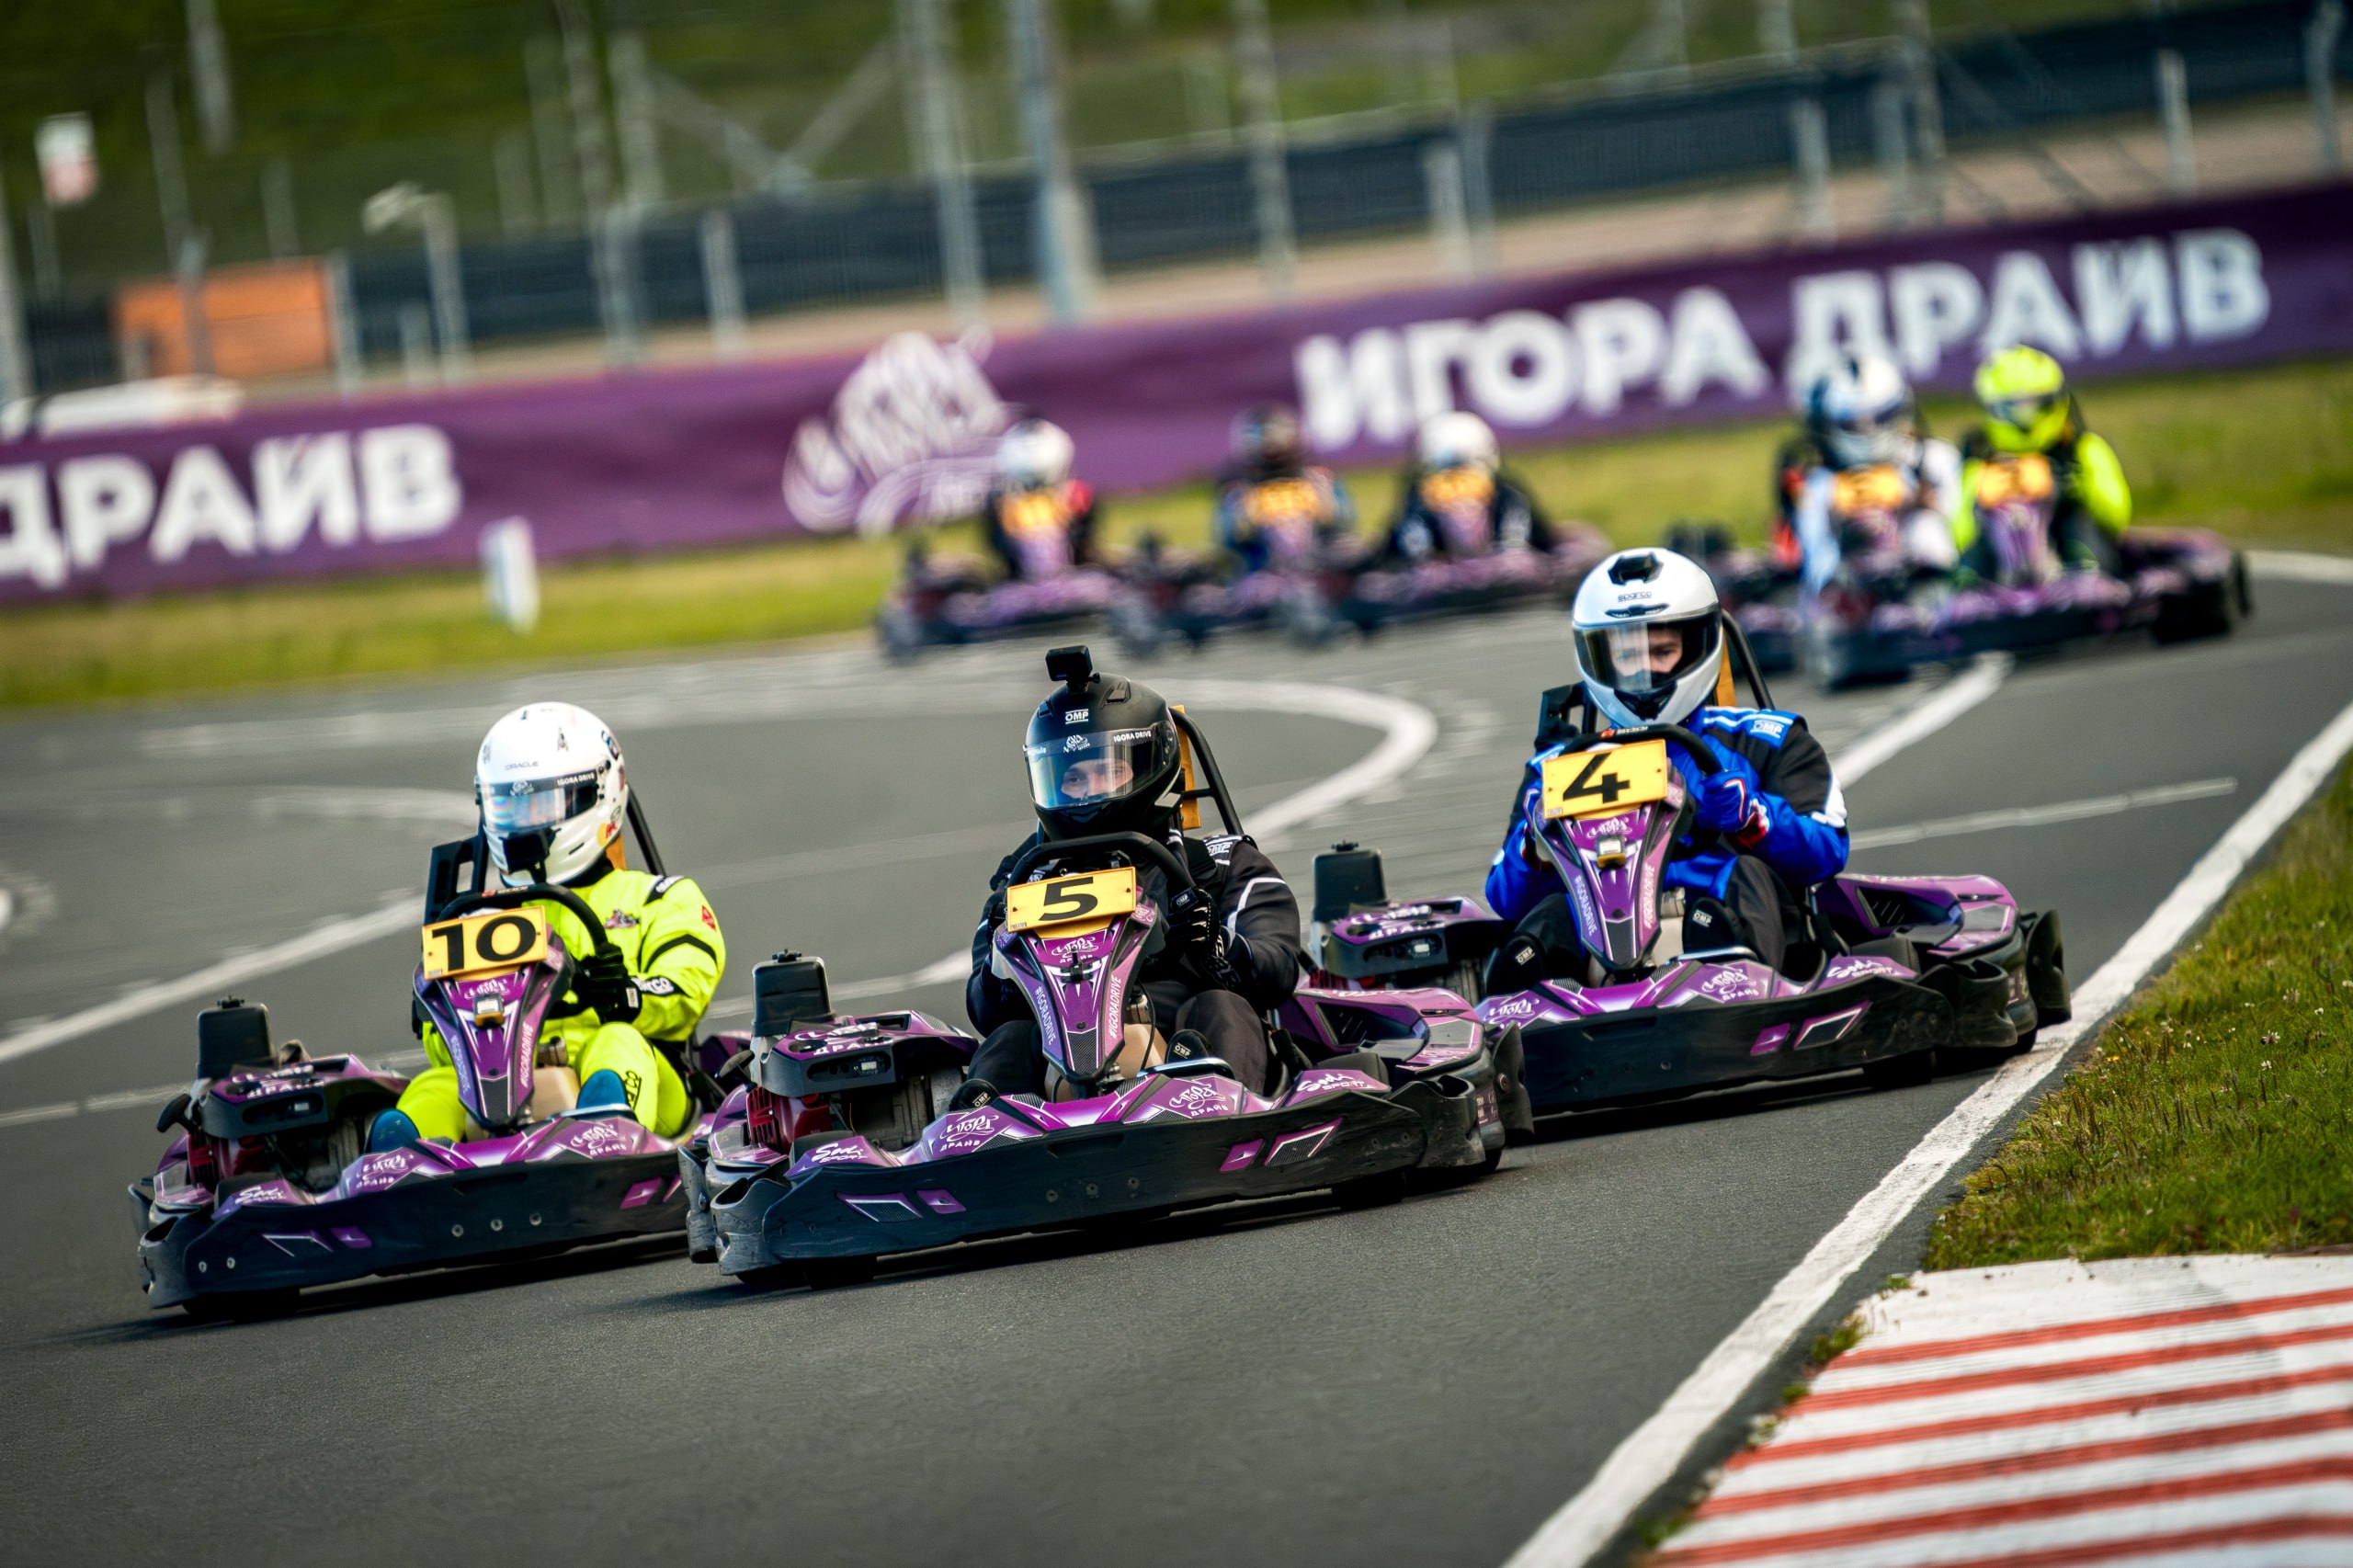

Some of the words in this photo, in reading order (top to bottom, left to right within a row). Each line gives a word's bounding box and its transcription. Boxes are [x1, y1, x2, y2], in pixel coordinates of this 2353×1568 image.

[1296, 283, 1771, 452] ИГОРА
[1064, 710, 1089, 722] OMP
[1752, 720, 1784, 735] OMP
[1113, 733, 1135, 743] IGORA
[1135, 731, 1152, 739] DRIVE
[505, 760, 540, 771] ORACLE
[557, 775, 578, 786] IGORA
[1563, 751, 1631, 804] 4
[1039, 876, 1098, 922] 5
[1693, 911, 1712, 925] OMP
[431, 915, 537, 972] 10
[1517, 948, 1534, 963] OMP
[1108, 975, 1121, 1040] #IGORADRIVE
[1035, 985, 1057, 1046] #IGORADRIVE
[1175, 1044, 1191, 1057] OMP
[1322, 1081, 1366, 1091] SPORT
[974, 1093, 988, 1108] OMP
